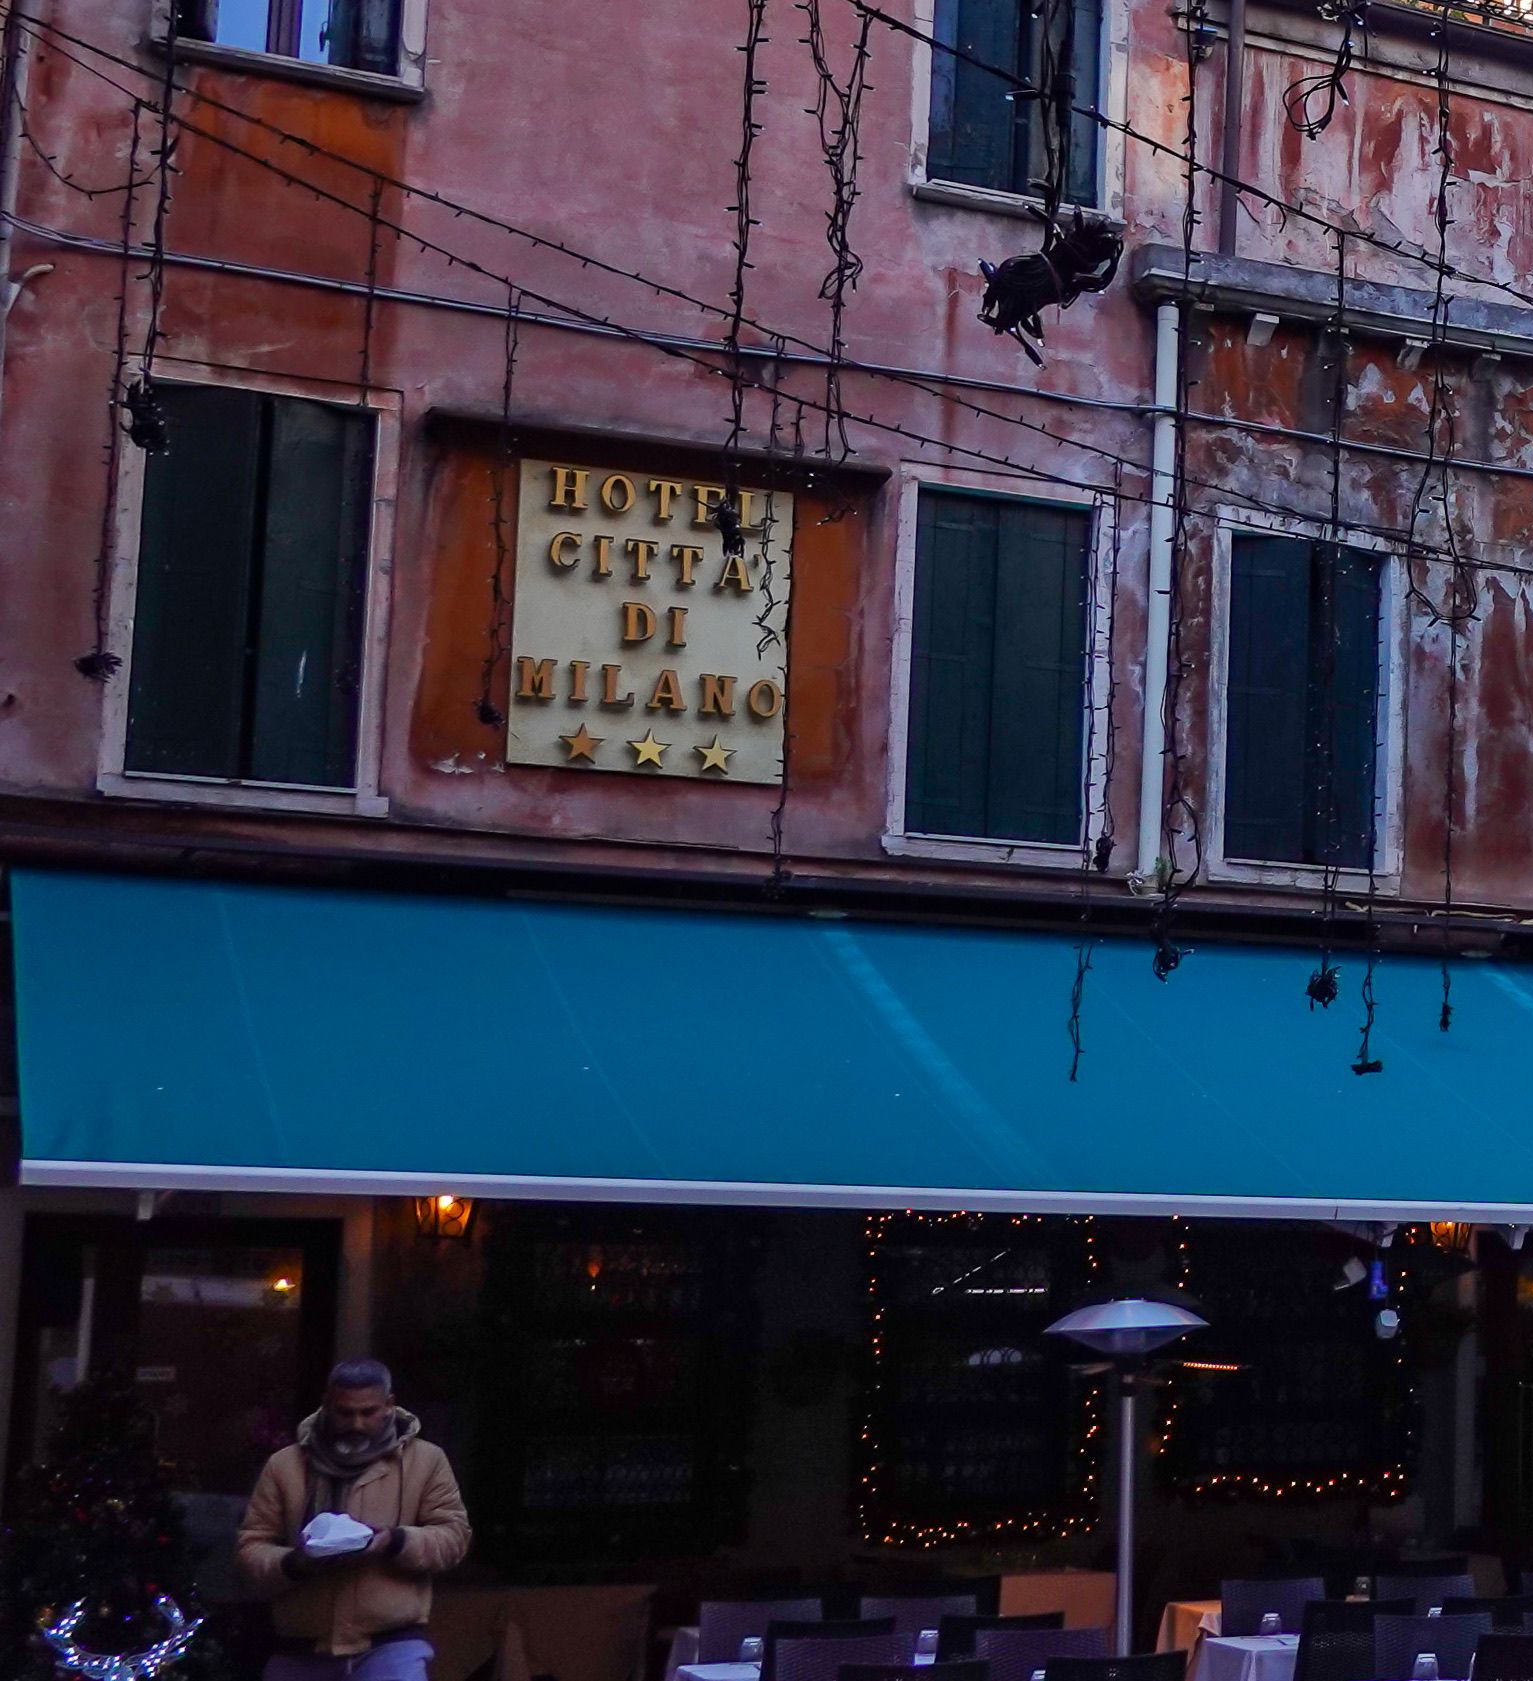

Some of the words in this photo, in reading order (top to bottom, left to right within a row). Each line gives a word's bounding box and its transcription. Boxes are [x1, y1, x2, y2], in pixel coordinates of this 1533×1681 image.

[550, 466, 767, 530] HOTEL
[622, 601, 689, 647] DI
[516, 655, 782, 718] MILANO
